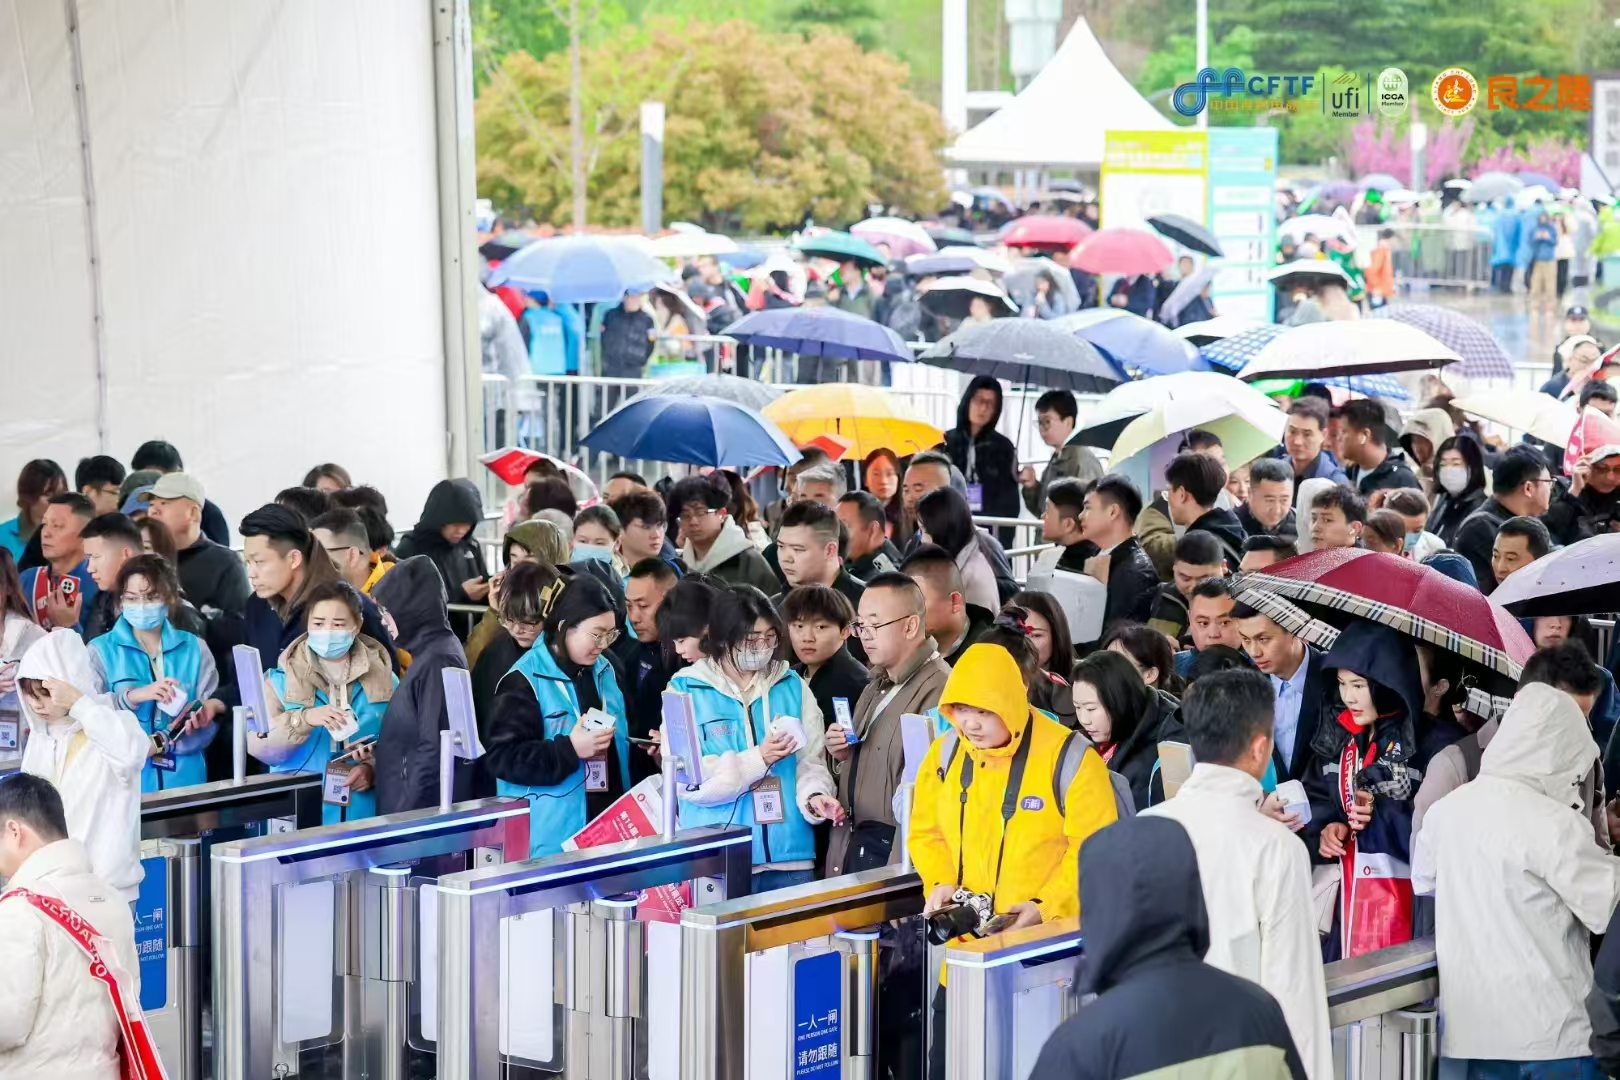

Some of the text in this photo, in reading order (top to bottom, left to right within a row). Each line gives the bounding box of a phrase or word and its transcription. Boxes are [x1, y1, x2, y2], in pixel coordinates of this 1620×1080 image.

[134, 908, 163, 924] 人一闸
[798, 1008, 838, 1031] 一人一闸
[806, 1031, 820, 1039] PERSON
[798, 1042, 838, 1067] 请勿跟随
[816, 1063, 824, 1071] NOT
